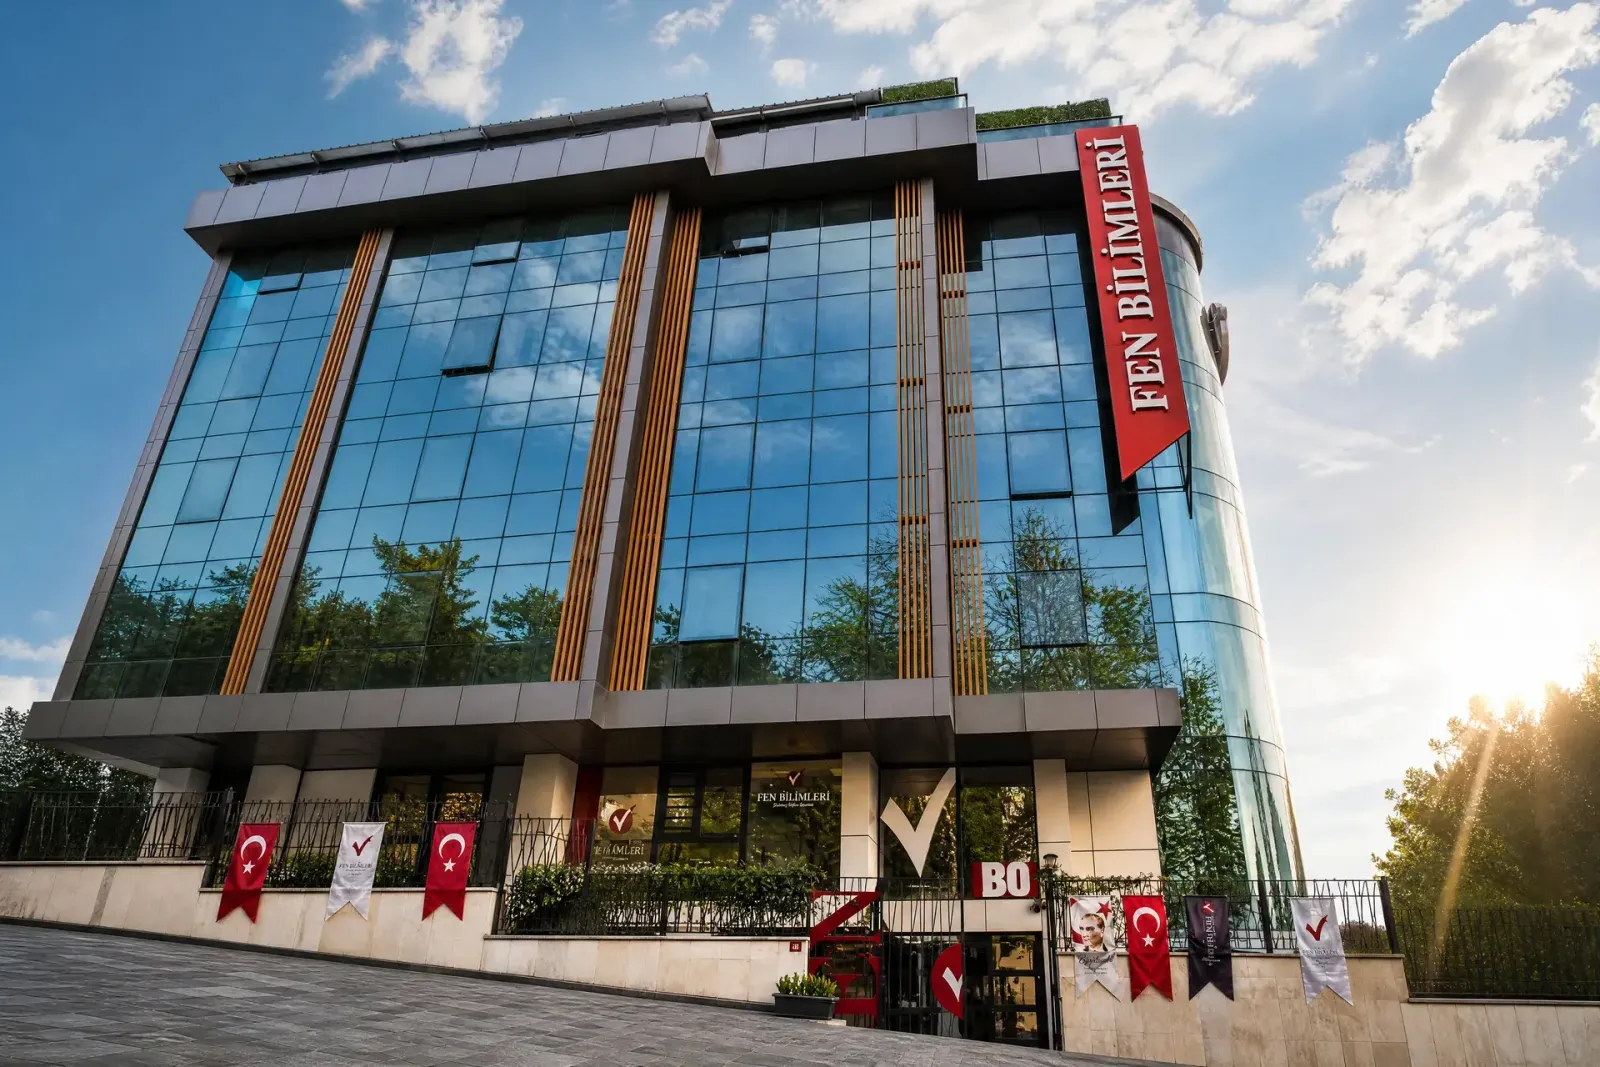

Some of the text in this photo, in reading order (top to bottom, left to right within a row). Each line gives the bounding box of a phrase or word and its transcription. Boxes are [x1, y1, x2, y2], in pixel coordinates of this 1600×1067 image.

[1085, 134, 1169, 412] FEN BİLİMLERİ
[757, 790, 830, 802] FEN BİLİMLERİ
